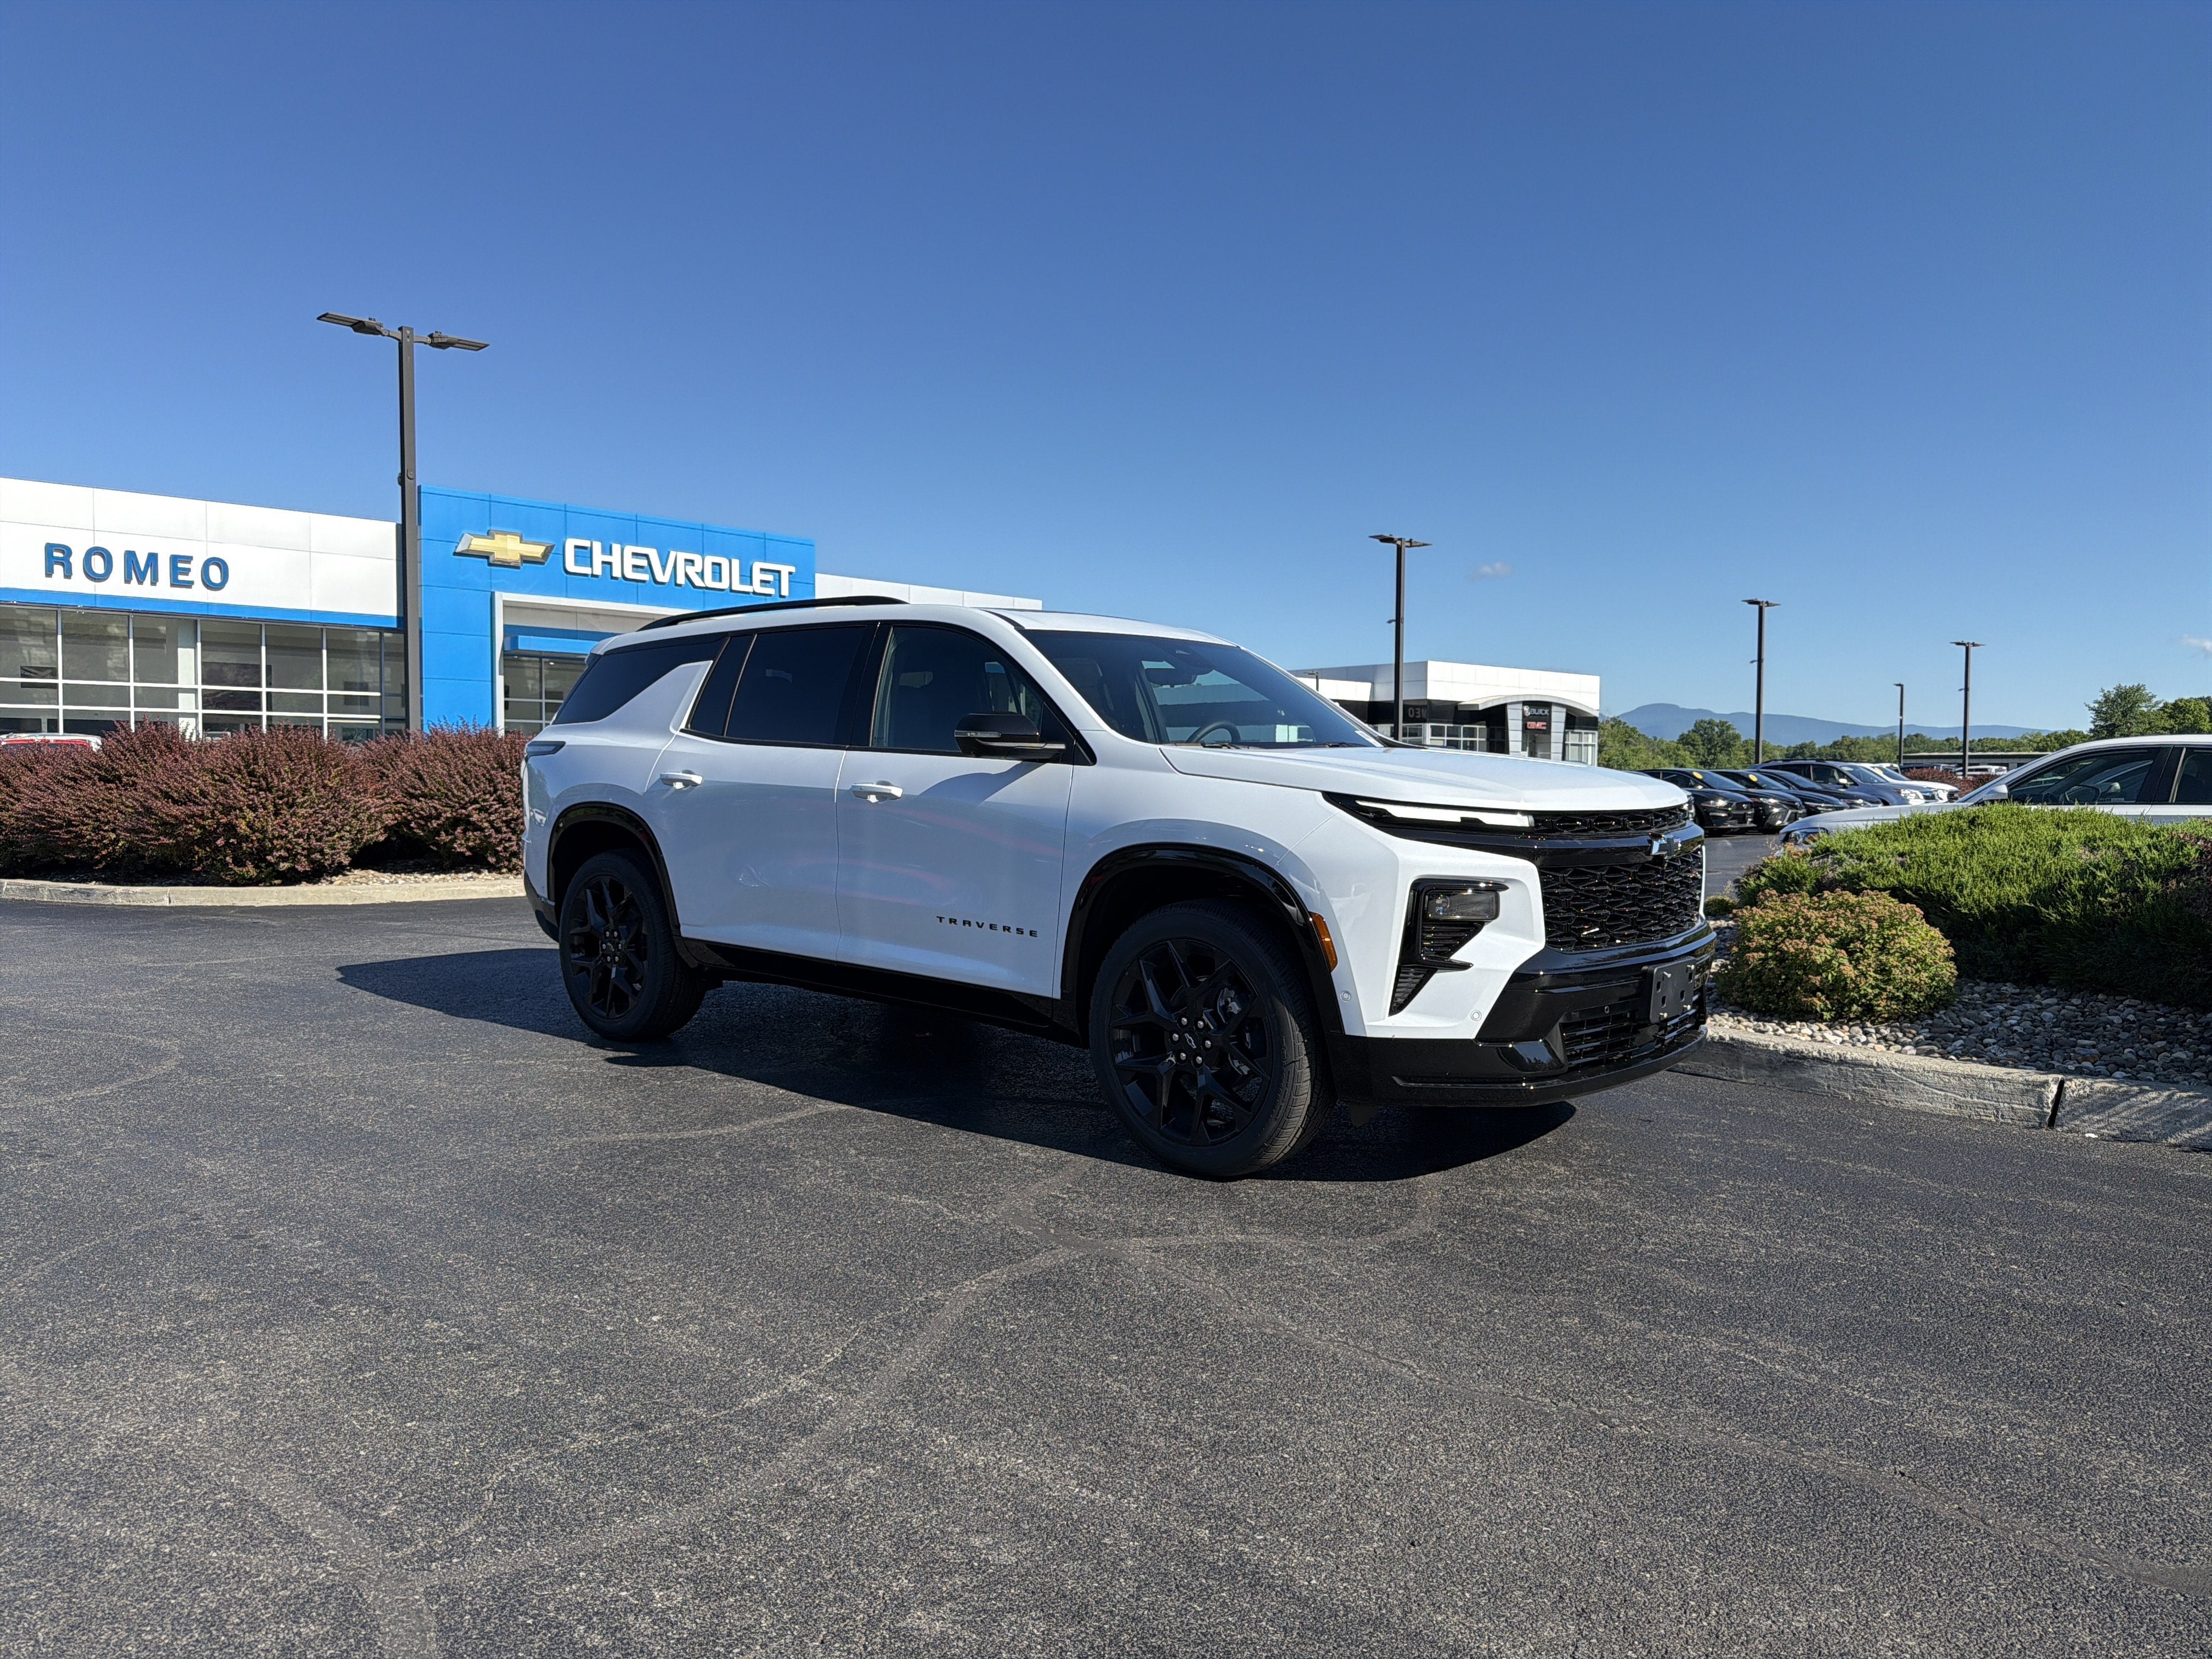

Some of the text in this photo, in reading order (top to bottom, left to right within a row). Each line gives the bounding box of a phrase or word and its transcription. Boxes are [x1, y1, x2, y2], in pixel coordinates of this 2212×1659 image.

[45, 543, 229, 590] ROMEO
[565, 538, 795, 597] CHEVROLET
[1527, 721, 1547, 730] GMC
[936, 916, 1038, 938] TRAVERSE
